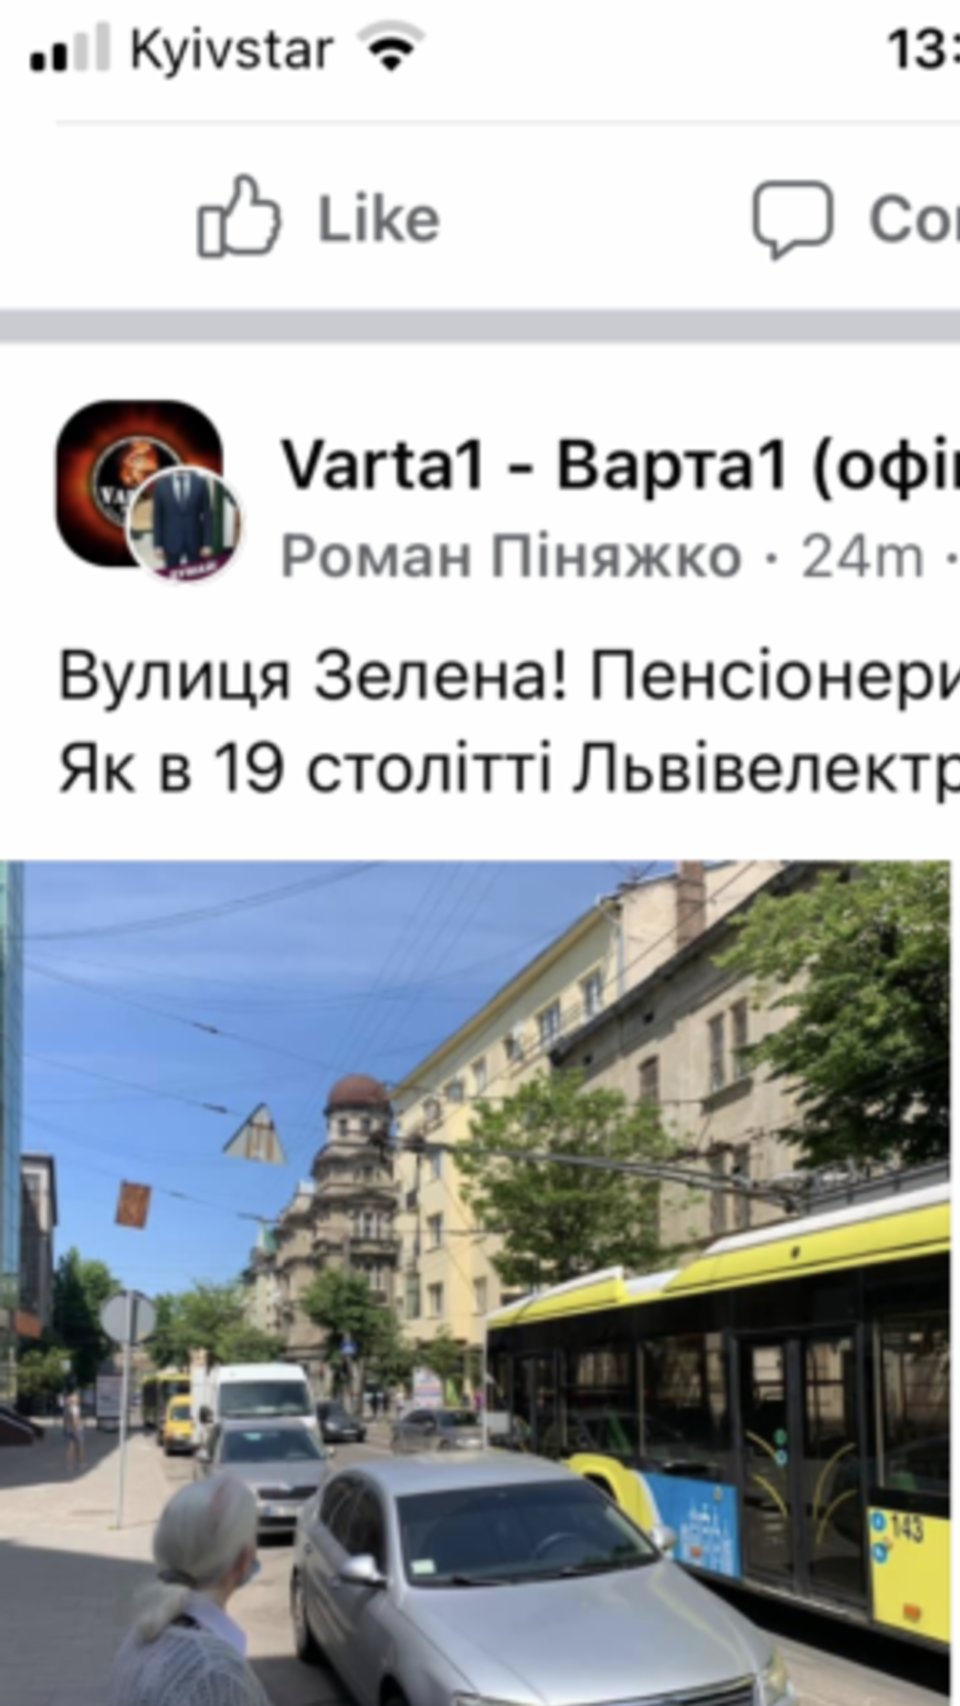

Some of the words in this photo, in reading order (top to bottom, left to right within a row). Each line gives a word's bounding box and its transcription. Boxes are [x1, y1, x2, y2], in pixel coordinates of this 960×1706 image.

[130, 26, 334, 80] Kyivstar
[319, 191, 440, 243] Like
[280, 438, 484, 490] Varta1
[558, 438, 784, 501] Варта1
[283, 533, 470, 578] Роман
[493, 530, 742, 578] Піняжко
[803, 533, 923, 578] 24m
[60, 647, 290, 713] Вулиця
[314, 647, 566, 702] Зелена!
[59, 741, 136, 794] Як
[159, 753, 192, 794] в
[214, 740, 285, 795] 19
[306, 739, 551, 795] столітті
[891, 1514, 924, 1544] 143
